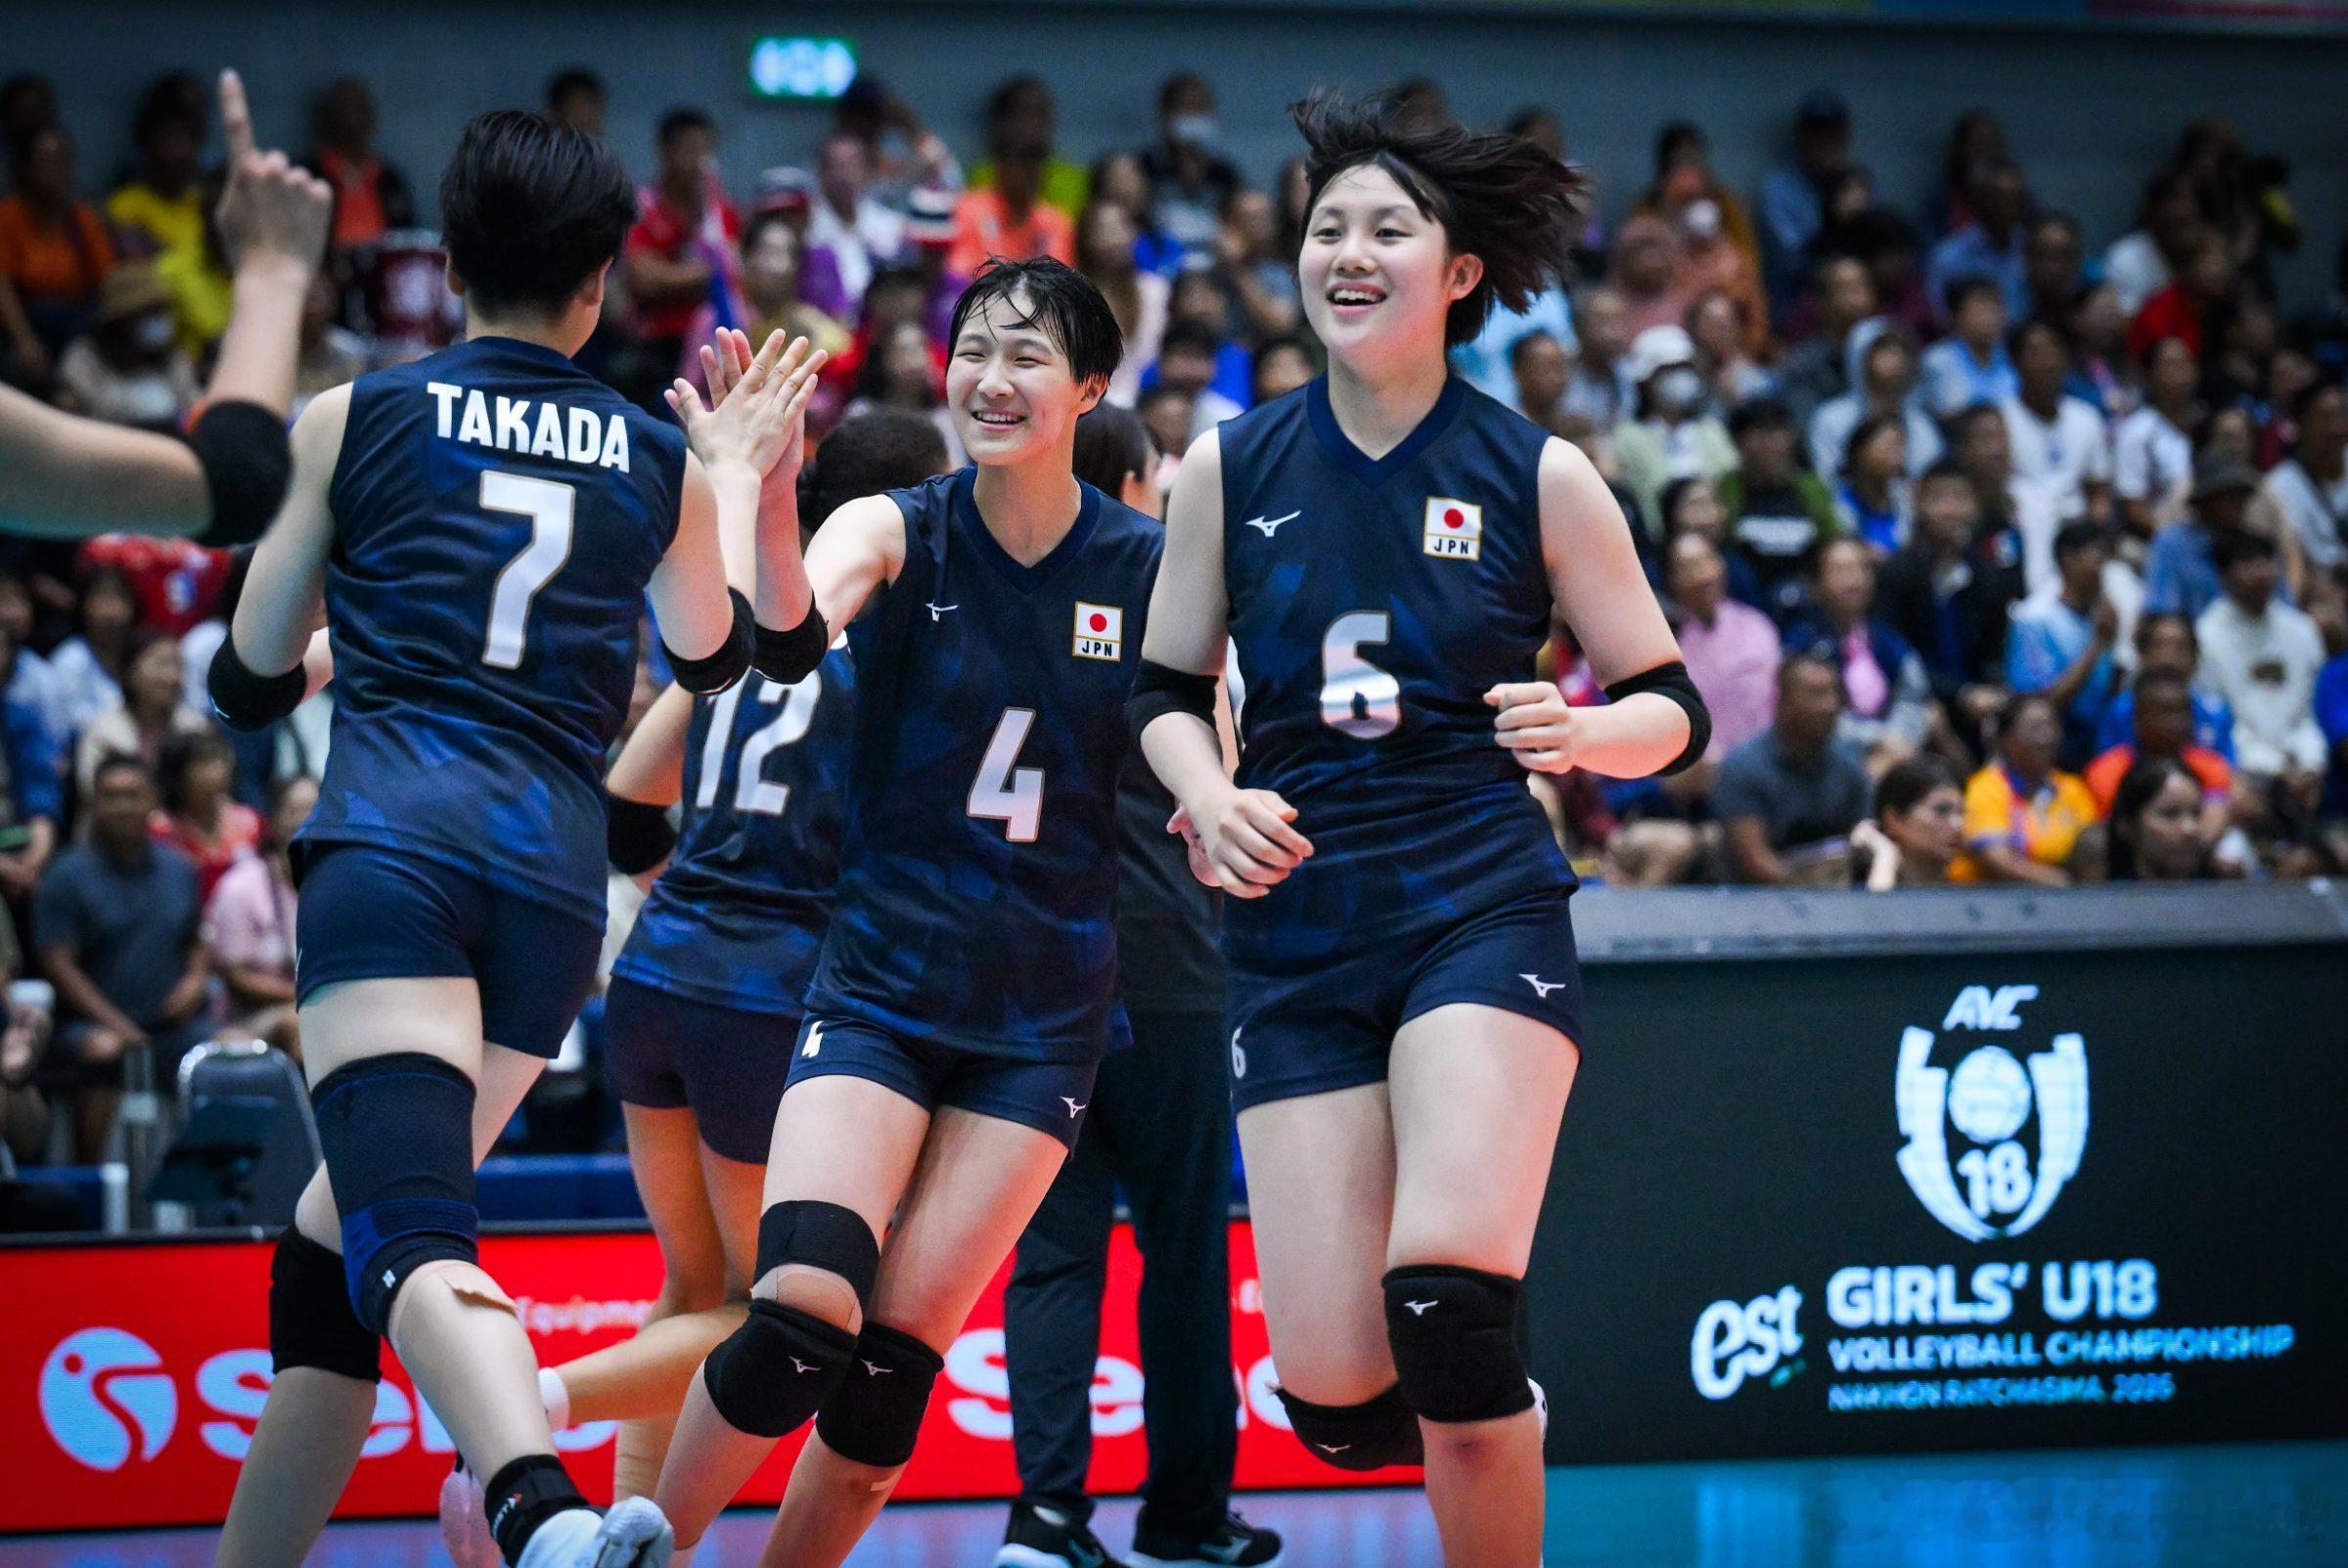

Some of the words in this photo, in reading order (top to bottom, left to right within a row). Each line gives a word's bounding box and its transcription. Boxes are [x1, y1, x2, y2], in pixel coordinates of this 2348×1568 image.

[427, 381, 630, 473] TAKADA
[478, 470, 576, 670] 7
[1433, 538, 1469, 555] JPN
[1081, 641, 1113, 657] JPN
[1319, 609, 1402, 740] 6
[695, 665, 823, 817] 12
[966, 705, 1046, 843] 4
[1943, 984, 2040, 1030] AVC
[1231, 1026, 1246, 1079] 6
[1957, 1140, 2033, 1218] 18
[1827, 1263, 2030, 1328] GIRLS'
[2042, 1259, 2158, 1321] U18
[1692, 1284, 1804, 1400] est
[1828, 1331, 2042, 1371] VOLLEYBALL
[2044, 1324, 2295, 1365] CHAMPIONSHIP
